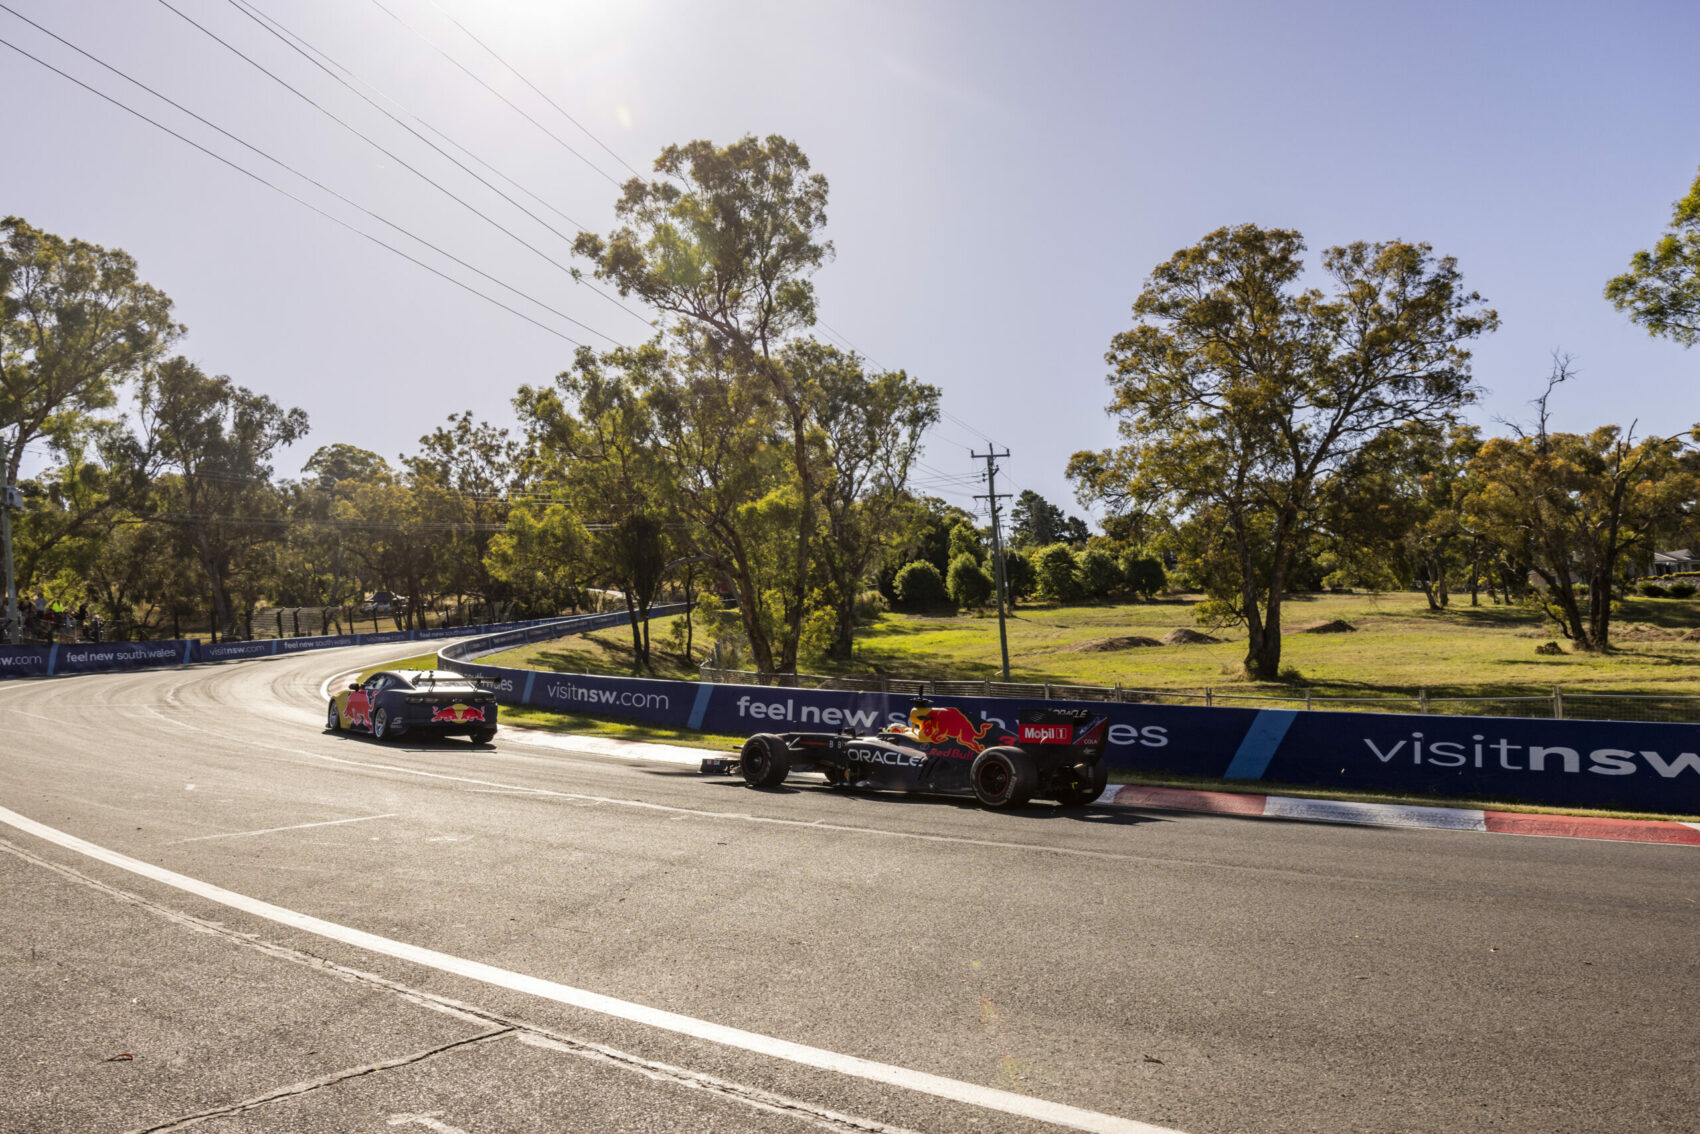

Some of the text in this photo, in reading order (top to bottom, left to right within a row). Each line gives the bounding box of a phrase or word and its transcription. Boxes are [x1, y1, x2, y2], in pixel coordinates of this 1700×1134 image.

[66, 648, 176, 662] feel new south wales
[210, 645, 265, 656] visitnsw.com
[0, 656, 42, 666] w.com
[547, 681, 669, 709] visitnsw.com
[737, 696, 793, 721] feel
[801, 705, 878, 728] new
[1024, 728, 1054, 739] Mobil
[848, 748, 924, 766] ORACLE
[930, 748, 974, 760] Red Bull
